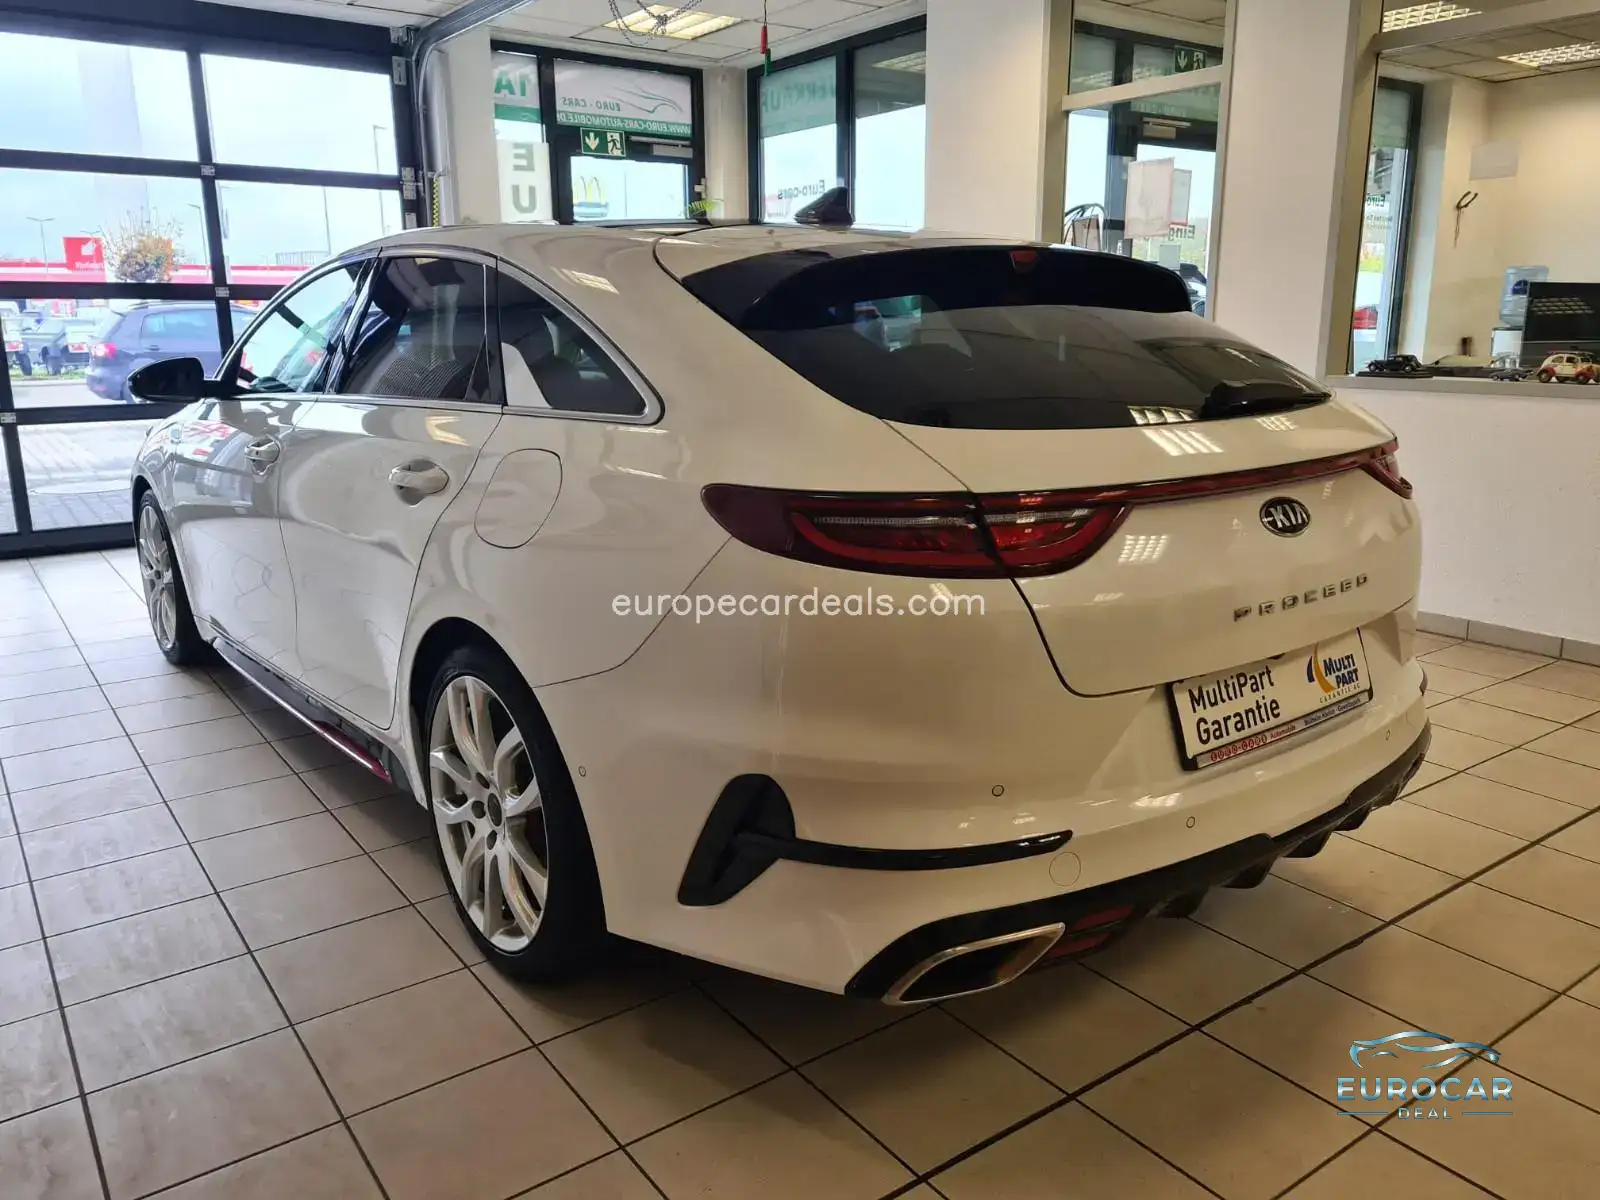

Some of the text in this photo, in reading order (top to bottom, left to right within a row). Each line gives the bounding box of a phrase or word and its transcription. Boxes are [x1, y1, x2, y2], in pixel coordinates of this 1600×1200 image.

[1269, 502, 1308, 529] KIA
[1233, 572, 1369, 622] PROCEED
[1322, 653, 1356, 677] MULTI
[1335, 667, 1359, 689] PART
[1187, 665, 1275, 714] MultiPart
[1196, 694, 1281, 746] Garantie
